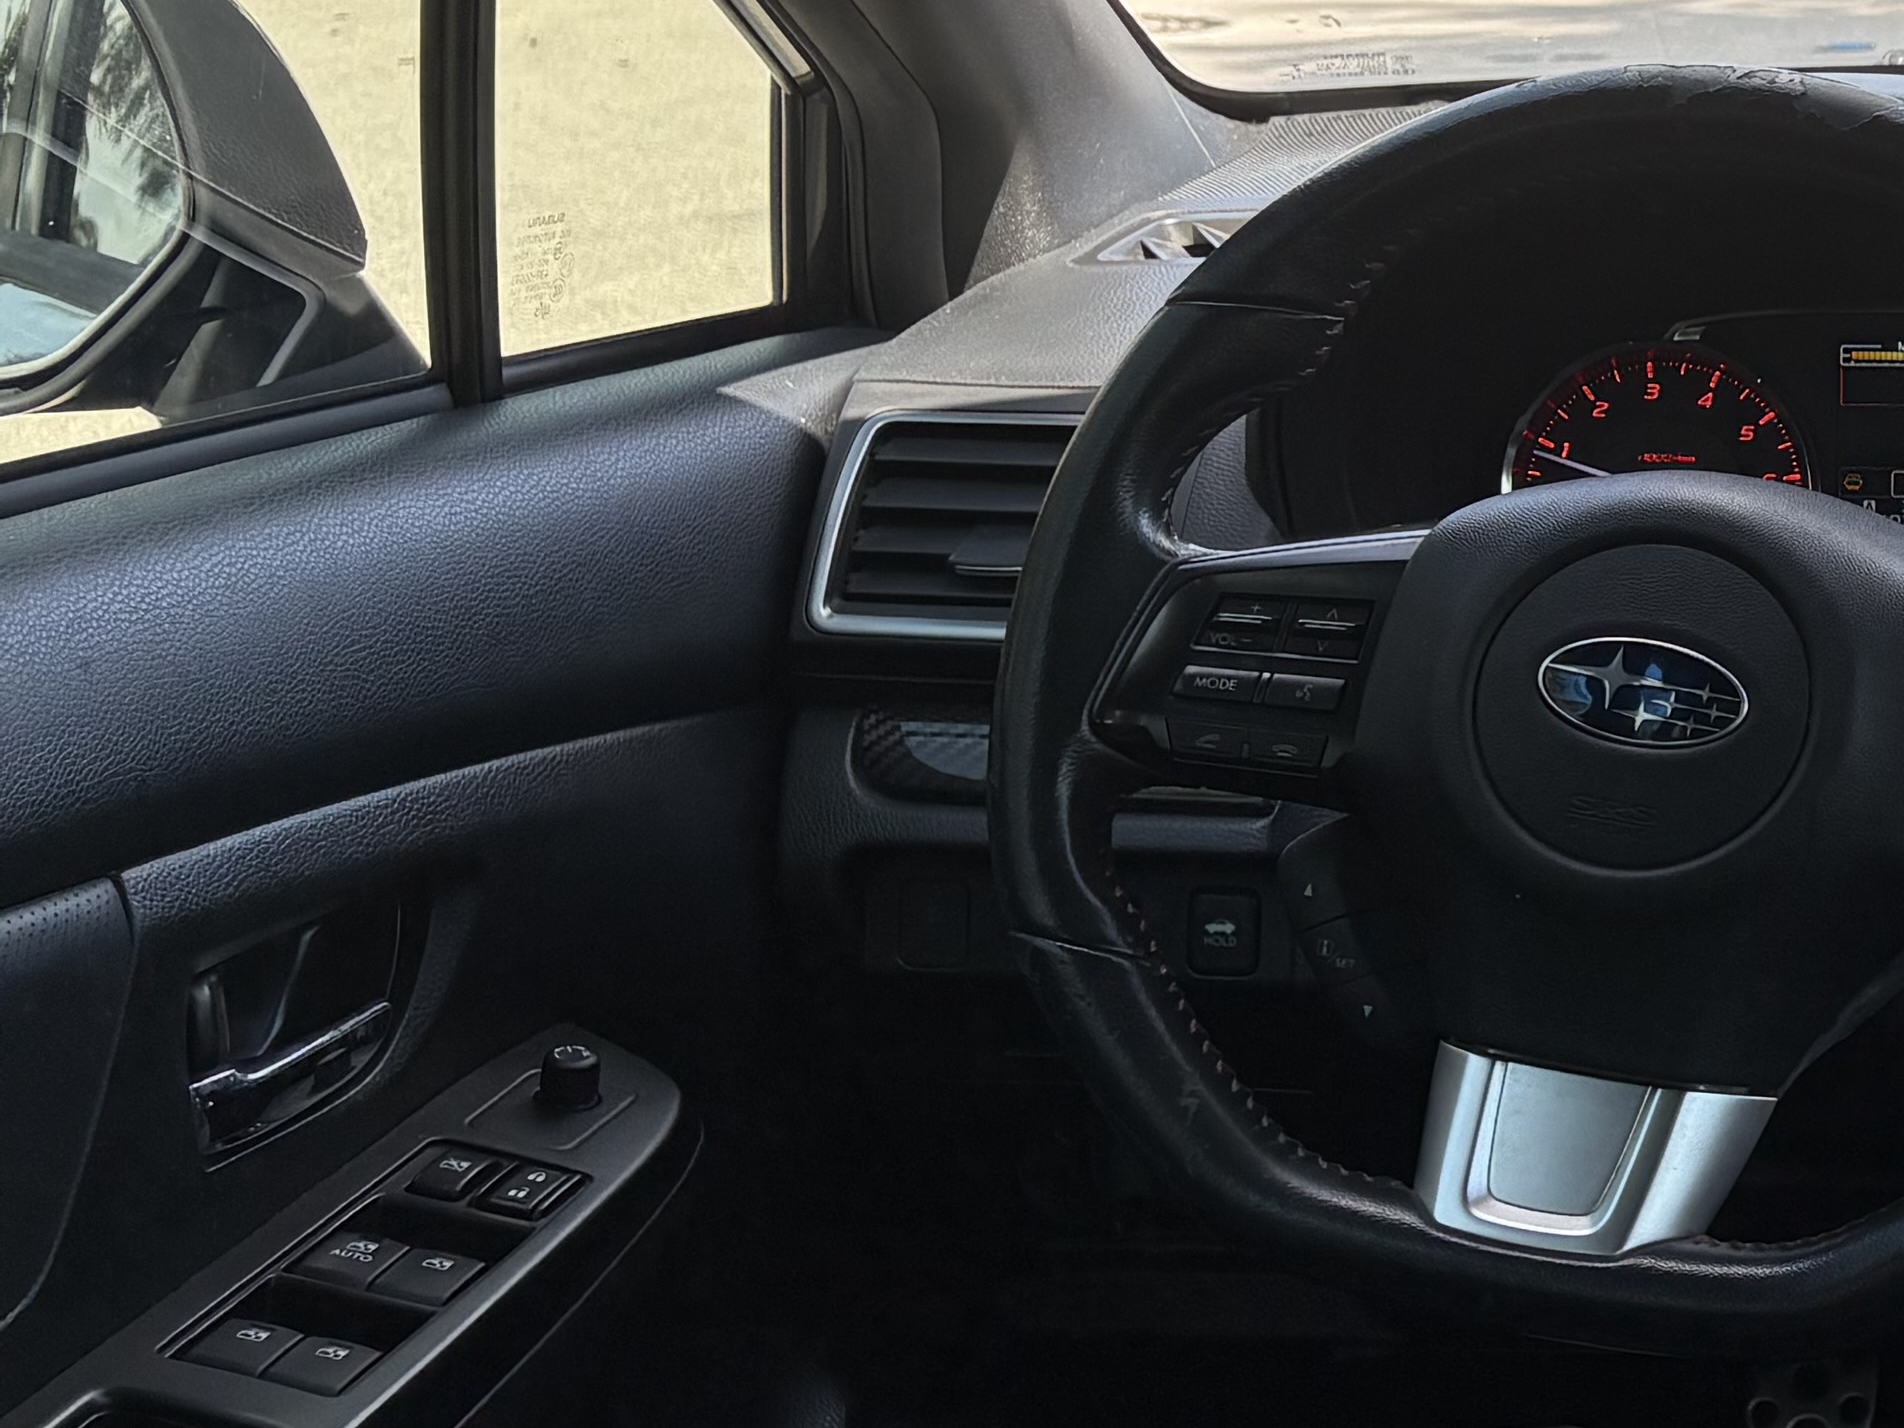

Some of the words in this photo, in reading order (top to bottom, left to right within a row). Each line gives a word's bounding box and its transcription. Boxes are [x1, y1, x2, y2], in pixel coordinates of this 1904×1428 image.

[1643, 383, 1662, 401] 3
[1697, 391, 1715, 410] 4
[1592, 401, 1610, 419] 2
[1738, 425, 1756, 442] 5
[1561, 442, 1571, 460] 1
[1193, 676, 1238, 692] MODE
[1203, 934, 1238, 948] HOLD
[329, 1248, 374, 1262] AUTO
